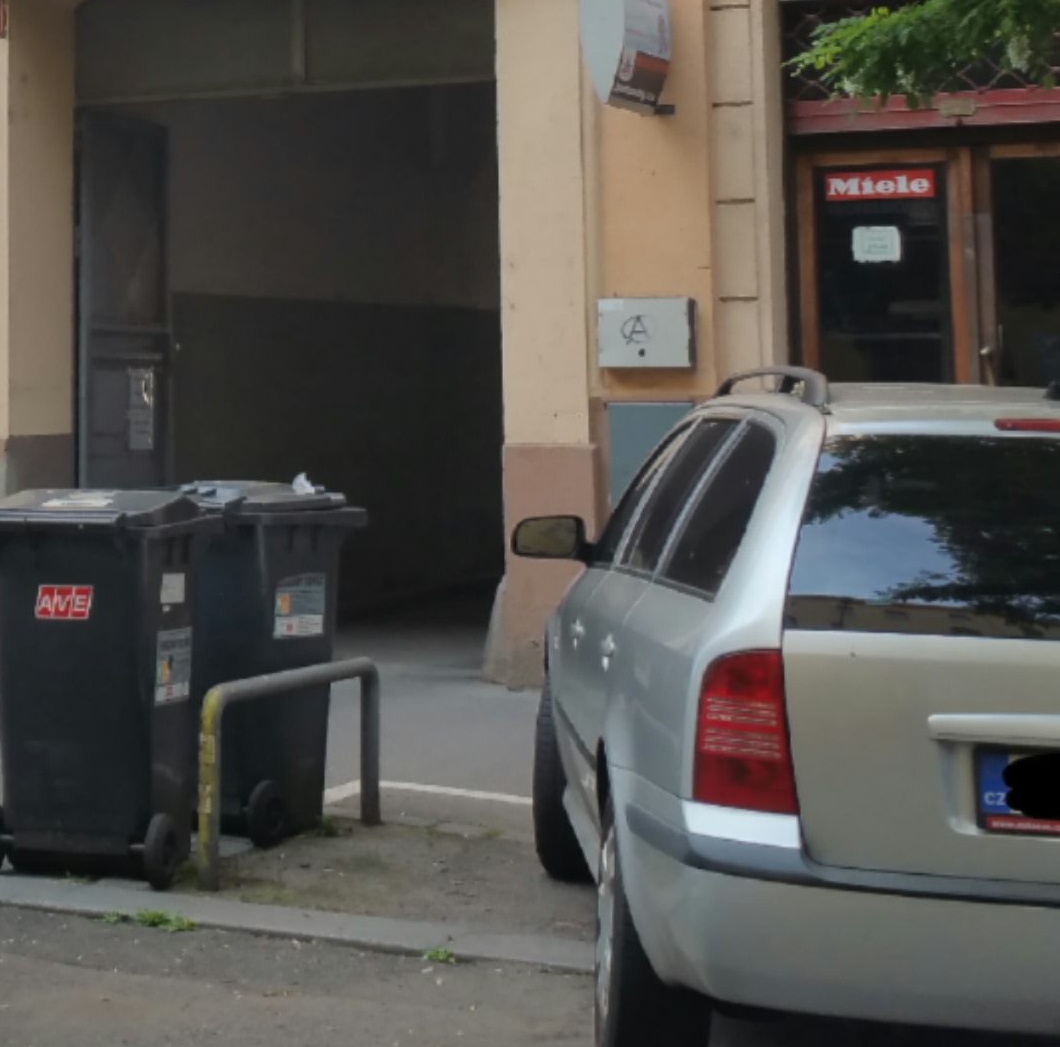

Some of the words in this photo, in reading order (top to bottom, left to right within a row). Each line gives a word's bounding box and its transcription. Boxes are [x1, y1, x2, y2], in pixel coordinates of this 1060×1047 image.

[828, 175, 931, 196] Miele
[38, 594, 88, 613] AVE
[984, 792, 1006, 806] CZ
